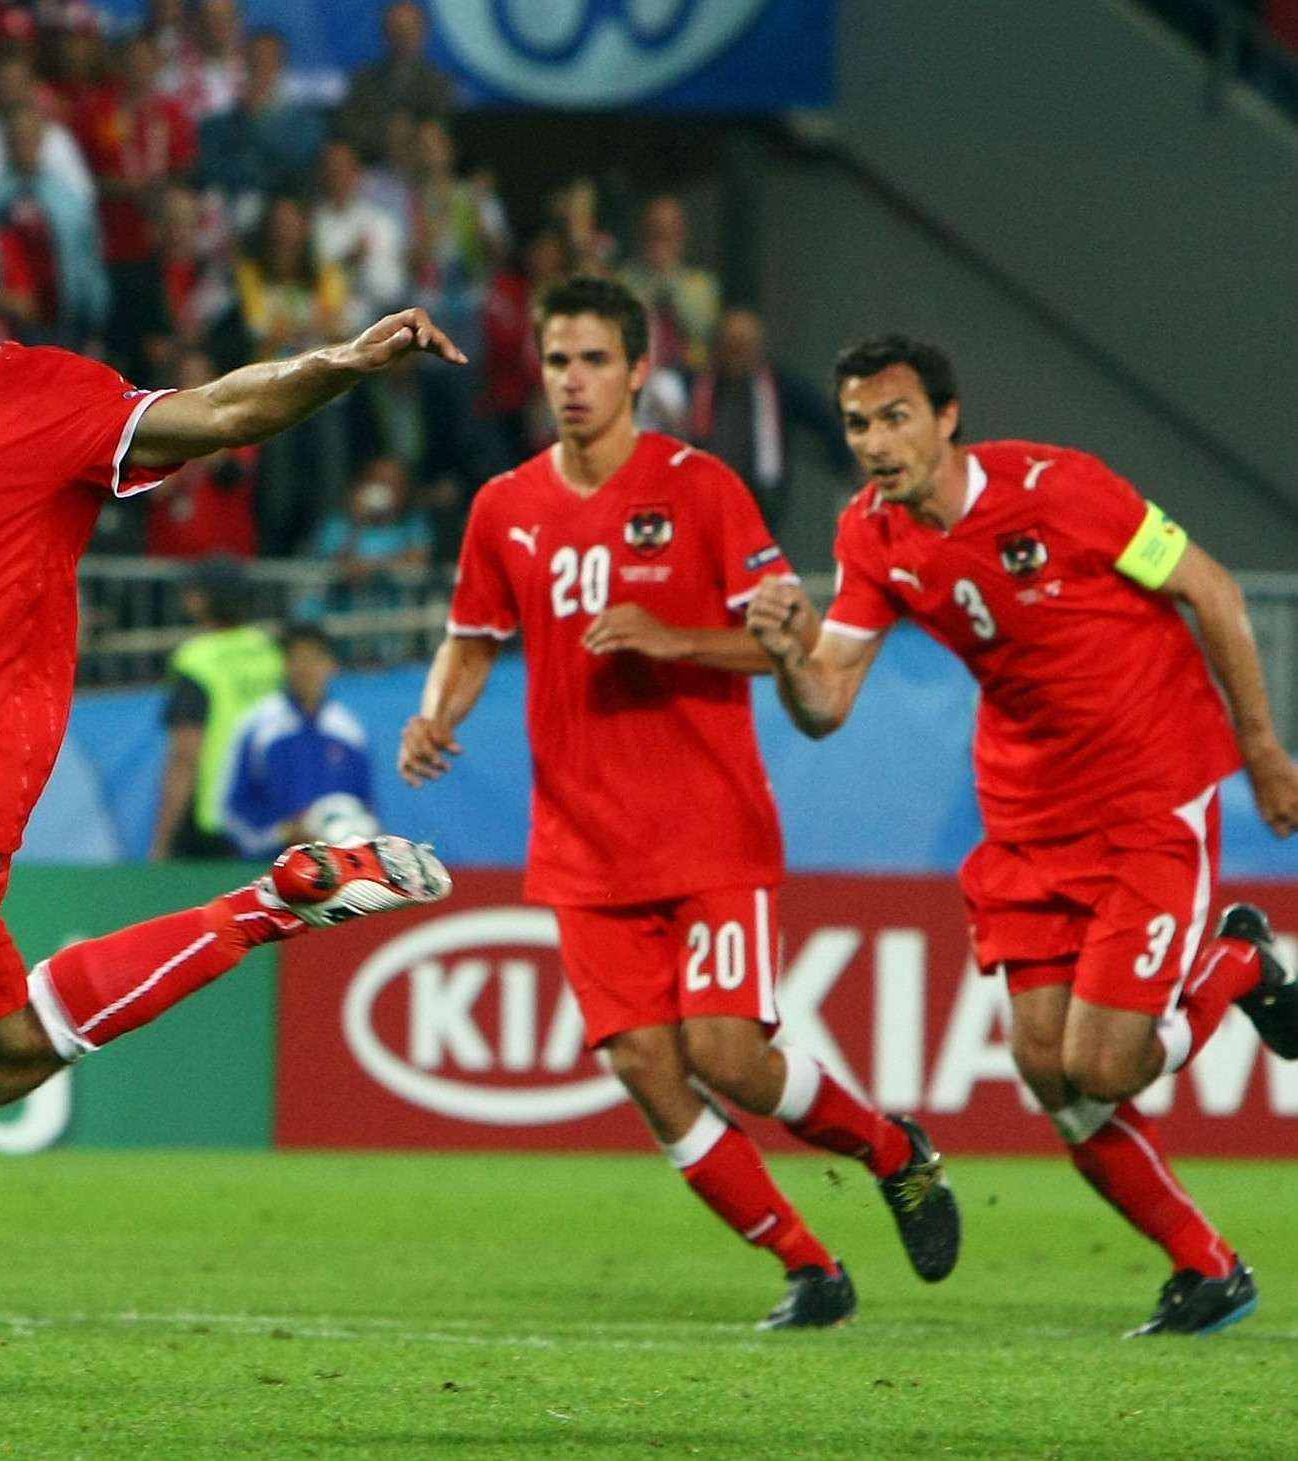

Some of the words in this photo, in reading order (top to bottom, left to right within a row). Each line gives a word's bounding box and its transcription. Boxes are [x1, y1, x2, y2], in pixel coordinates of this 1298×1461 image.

[550, 544, 611, 620] 20
[954, 578, 996, 640] 3
[685, 920, 746, 993] 20
[1129, 913, 1177, 979] 3
